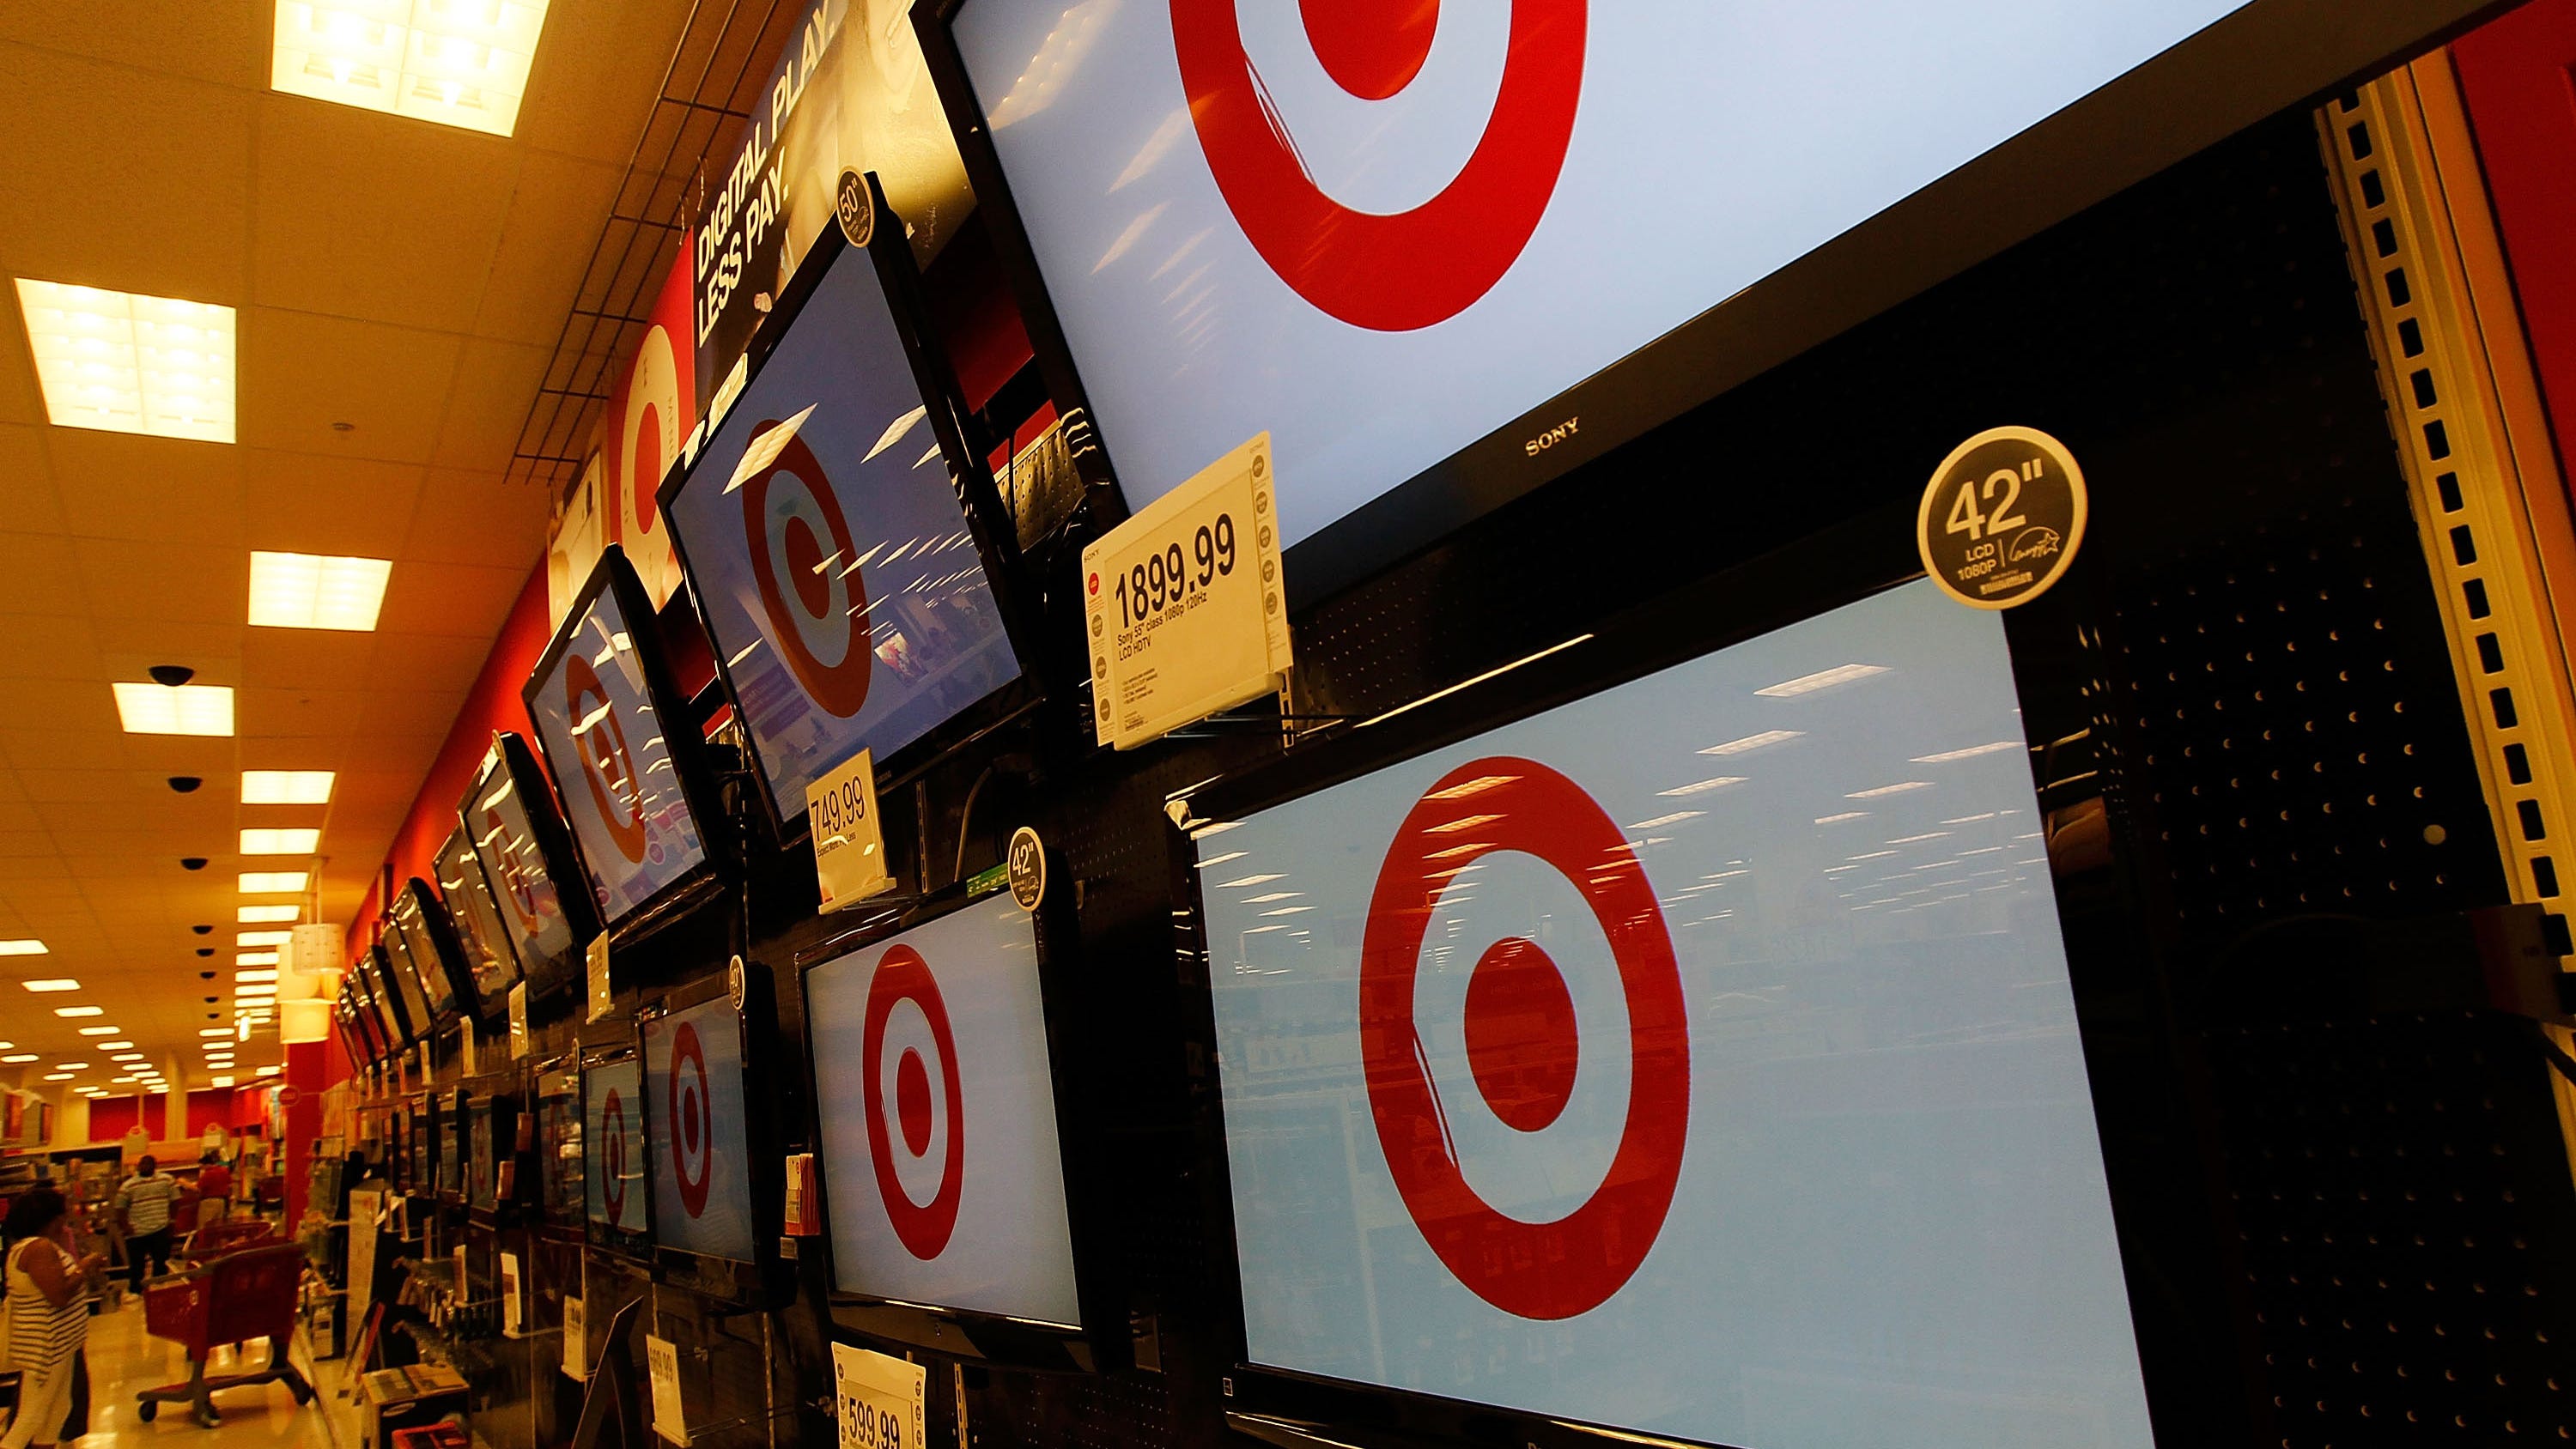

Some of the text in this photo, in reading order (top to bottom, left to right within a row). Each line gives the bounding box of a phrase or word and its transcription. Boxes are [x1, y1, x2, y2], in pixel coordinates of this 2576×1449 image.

[698, 0, 835, 282] DIGITAL PLAY.
[840, 178, 858, 222] 50"
[698, 146, 789, 349] LESS PAY.
[1525, 416, 1579, 457] SONY
[1946, 458, 2043, 540] 42"
[1115, 513, 1236, 629] 1899.99
[1958, 559, 1997, 580] 1080P
[1965, 543, 1995, 561] LCD
[1118, 591, 1208, 646] Sony 55" class 1080p 120Hz
[1119, 635, 1151, 661] LCD HDTV
[811, 776, 864, 841] 749.99
[1013, 842, 1034, 876] 42"
[849, 1397, 900, 1449] 599.99
